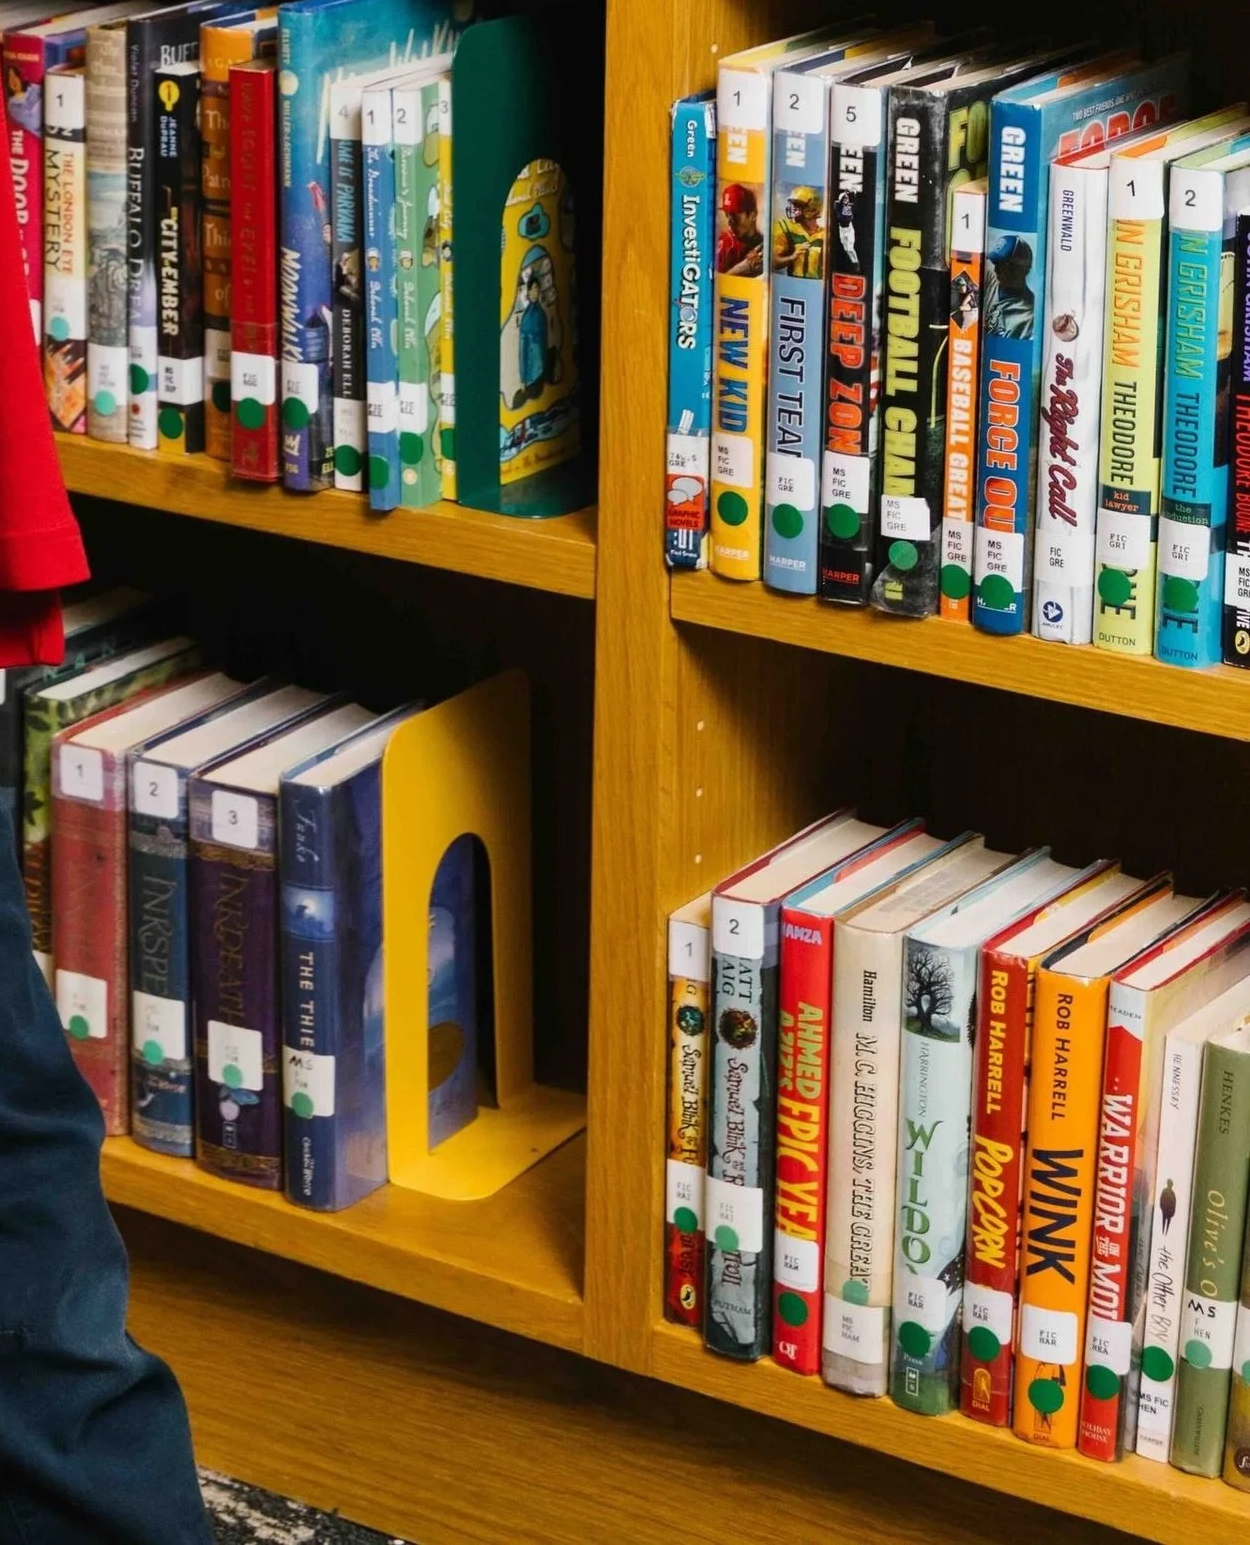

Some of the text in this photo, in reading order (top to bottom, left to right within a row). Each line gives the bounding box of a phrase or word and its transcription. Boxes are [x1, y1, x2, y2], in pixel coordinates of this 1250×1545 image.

[169, 116, 178, 158] JEANNE
[686, 120, 697, 158] Green
[789, 93, 800, 110] 2
[846, 106, 857, 123] 5
[895, 117, 921, 204] GREEN
[998, 126, 1027, 214] GREEN
[45, 148, 62, 272] MYSTERY
[337, 182, 355, 243] PARVANA
[1060, 189, 1075, 252] GREENWALD
[161, 266, 179, 336] EMBER
[678, 194, 701, 350] InvestiGATORS
[885, 226, 922, 396] FOOTBALL
[1112, 252, 1144, 369] GRISHAM
[778, 296, 806, 383] FIRST
[829, 273, 867, 370] DEEP
[1174, 263, 1207, 379] GRISHAM
[718, 297, 749, 433] NEW KID
[949, 338, 974, 445] BASEBALL
[986, 358, 1021, 471] FORCE
[1041, 353, 1080, 528] The Right Call
[1111, 381, 1138, 485] THEODORE
[1172, 392, 1200, 497] THEODORE
[1103, 499, 1139, 513] lawyer
[1114, 489, 1130, 502] kid
[769, 555, 806, 569] HARPER
[1099, 631, 1136, 646] DUTTON
[729, 918, 740, 936] 2
[299, 952, 314, 991] THE
[862, 969, 877, 1023] Hamilton
[796, 1001, 823, 1100] AHMED
[917, 1041, 930, 1119] HARRINGTON
[986, 969, 1009, 1115] ROB HARRELL
[1051, 992, 1074, 1122] ROB HARRELL
[1170, 1053, 1183, 1110] HENNESSEY
[777, 1095, 821, 1174] EPIC
[1218, 1070, 1234, 1135] HENKES
[851, 1178, 875, 1217] THE
[972, 1133, 1014, 1269] POPCORN
[1096, 1092, 1133, 1235] WARRIOR
[1026, 1148, 1084, 1285] WINK
[1188, 1299, 1216, 1319] MS
[1194, 1328, 1211, 1340] HEN
